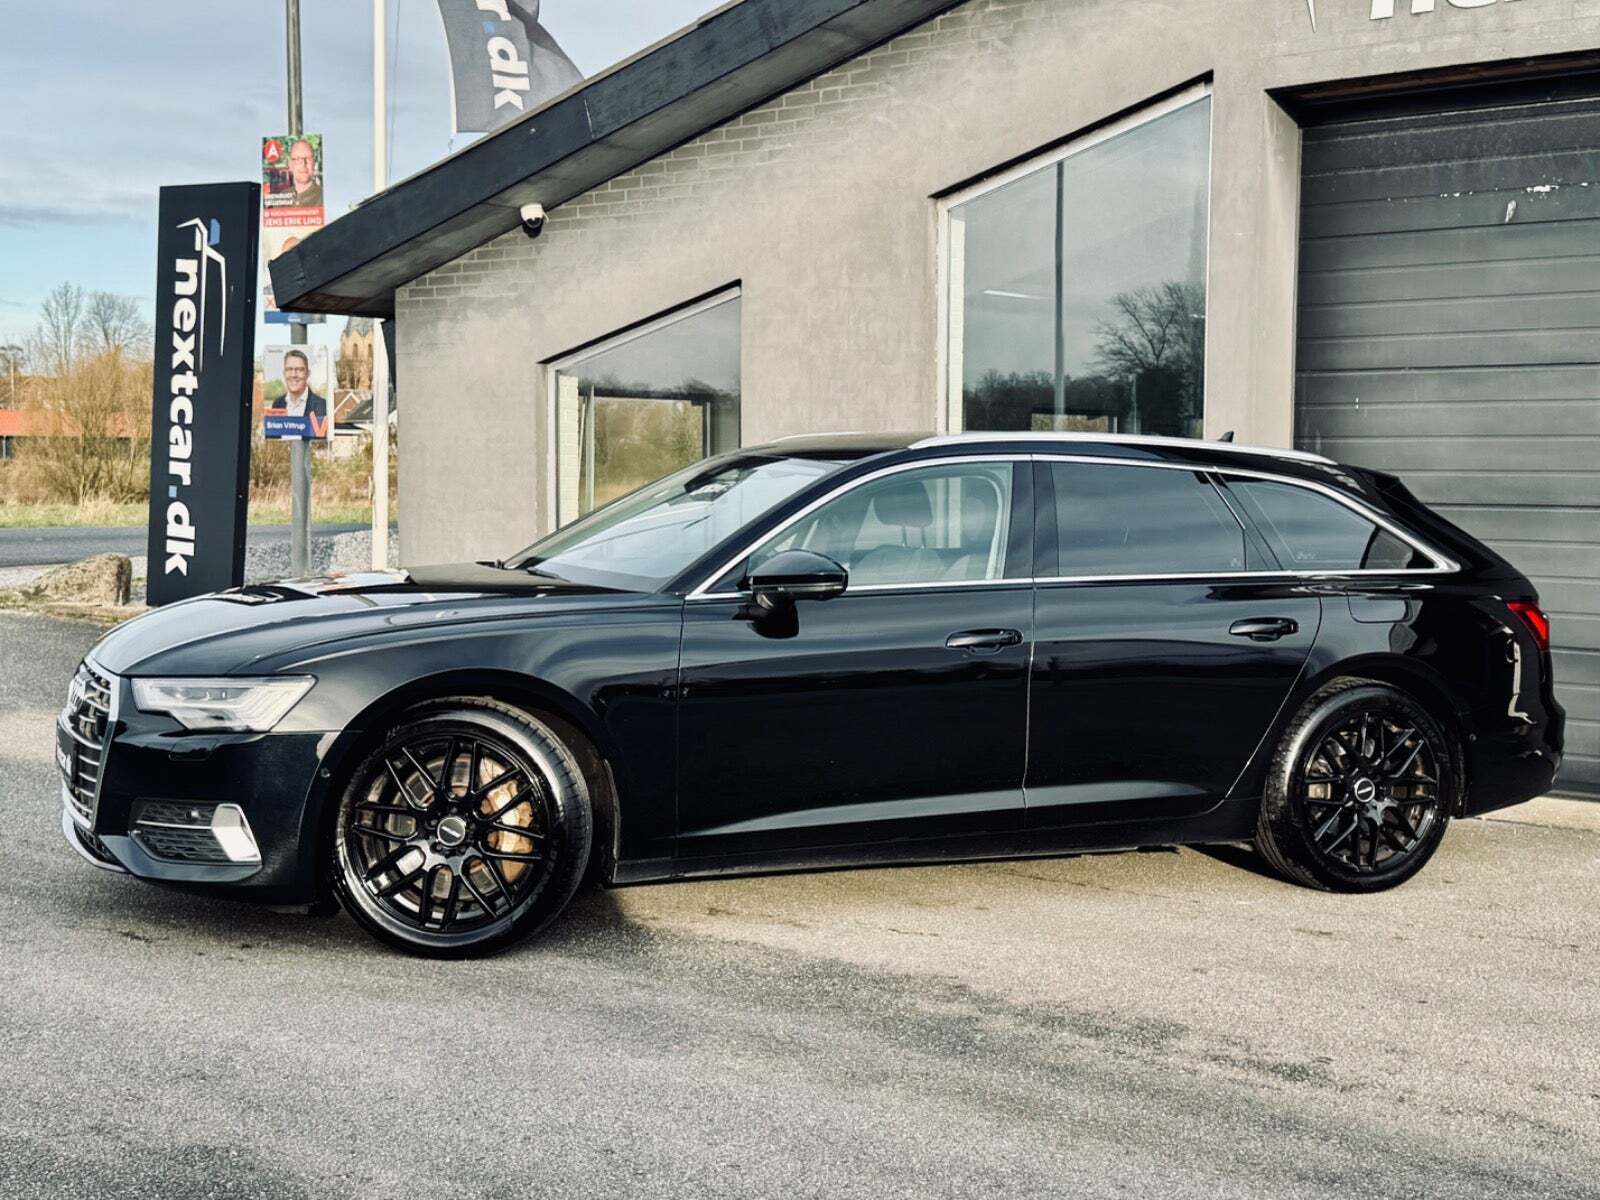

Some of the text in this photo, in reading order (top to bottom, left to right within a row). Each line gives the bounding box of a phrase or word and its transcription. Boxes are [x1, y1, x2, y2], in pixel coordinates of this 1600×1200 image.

[267, 143, 280, 160] A
[284, 217, 302, 225] ERIK
[303, 216, 322, 225] LIND
[165, 258, 199, 577] nextcar.dk
[267, 421, 283, 429] Brian
